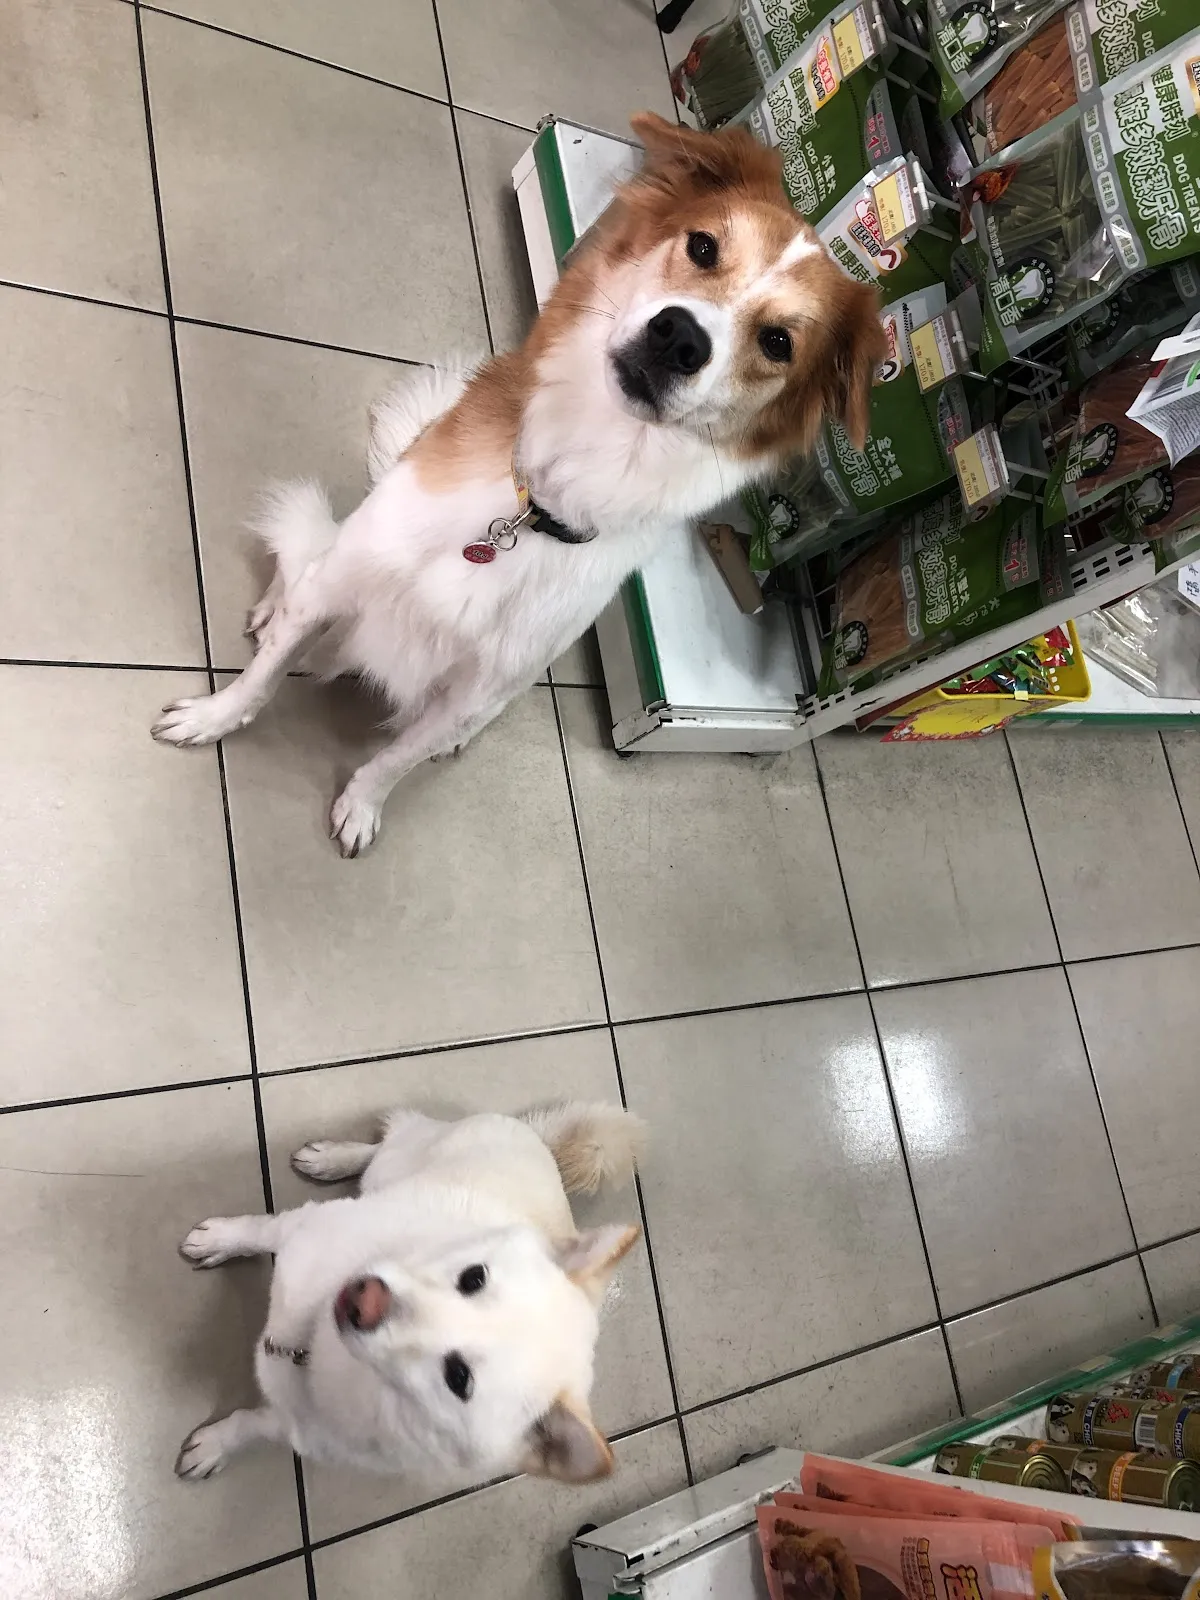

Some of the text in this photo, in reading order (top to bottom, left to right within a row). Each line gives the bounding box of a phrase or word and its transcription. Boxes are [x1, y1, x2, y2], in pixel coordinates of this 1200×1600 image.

[1142, 30, 1156, 57] DOG
[788, 67, 817, 135] 健康時刻
[1151, 64, 1191, 141] 健康時刻
[767, 80, 820, 215] 螺旋多效潔牙骨
[1114, 81, 1188, 250] 螺旋多效潔牙骨
[805, 141, 828, 202] DOG TREATS
[822, 154, 837, 195] 小型犬
[1173, 153, 1200, 234] DOG TREATS
[882, 215, 891, 235] 170.0
[990, 275, 1021, 326] 清口香
[1070, 319, 1092, 349] 口香
[919, 363, 929, 383] 170.0
[829, 419, 880, 496] 效潔牙骨
[868, 444, 891, 486] TREATS
[964, 477, 974, 499] 170.0
[1112, 1465, 1123, 1489] BEEF
